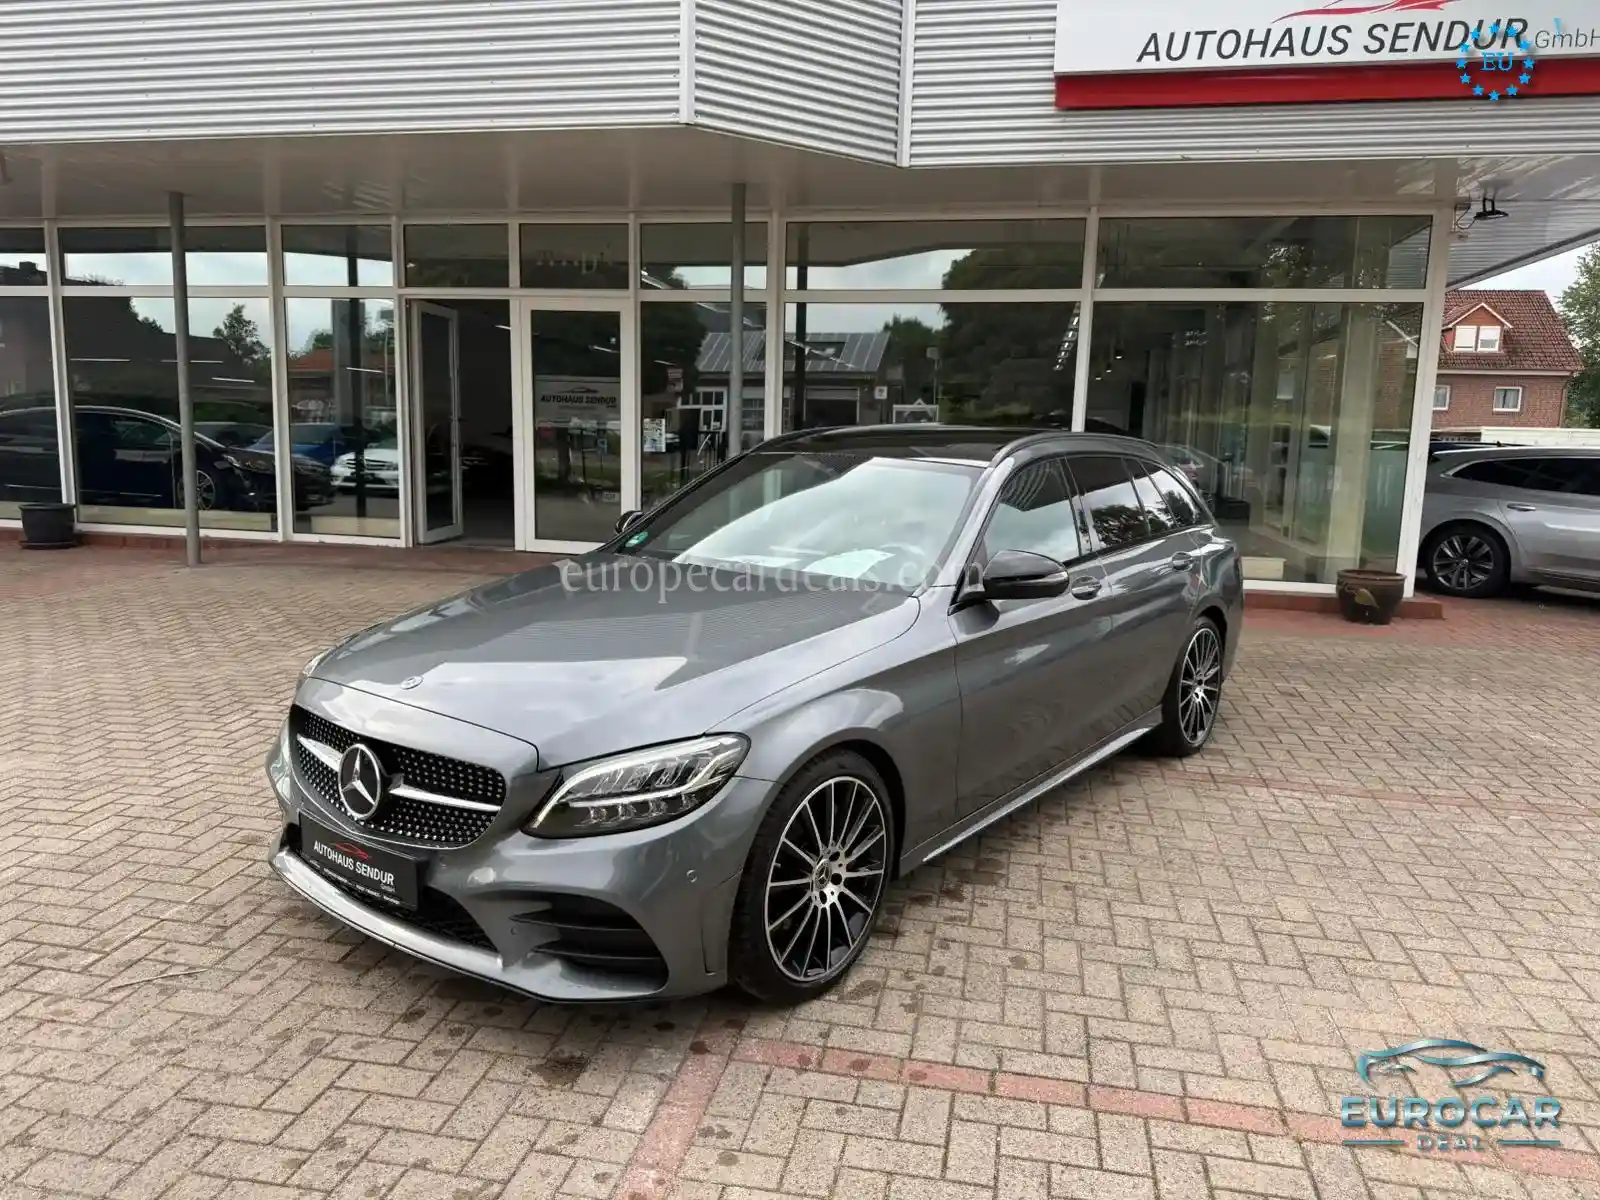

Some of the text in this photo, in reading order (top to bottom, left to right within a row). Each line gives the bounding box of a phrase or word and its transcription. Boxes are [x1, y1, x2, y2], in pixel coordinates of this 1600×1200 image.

[1136, 24, 1353, 62] AUTOHAUS
[1363, 18, 1528, 54] SENDUR
[541, 394, 584, 403] AUTOHAUS
[313, 840, 395, 885] AUTOHAUS SENDUR
